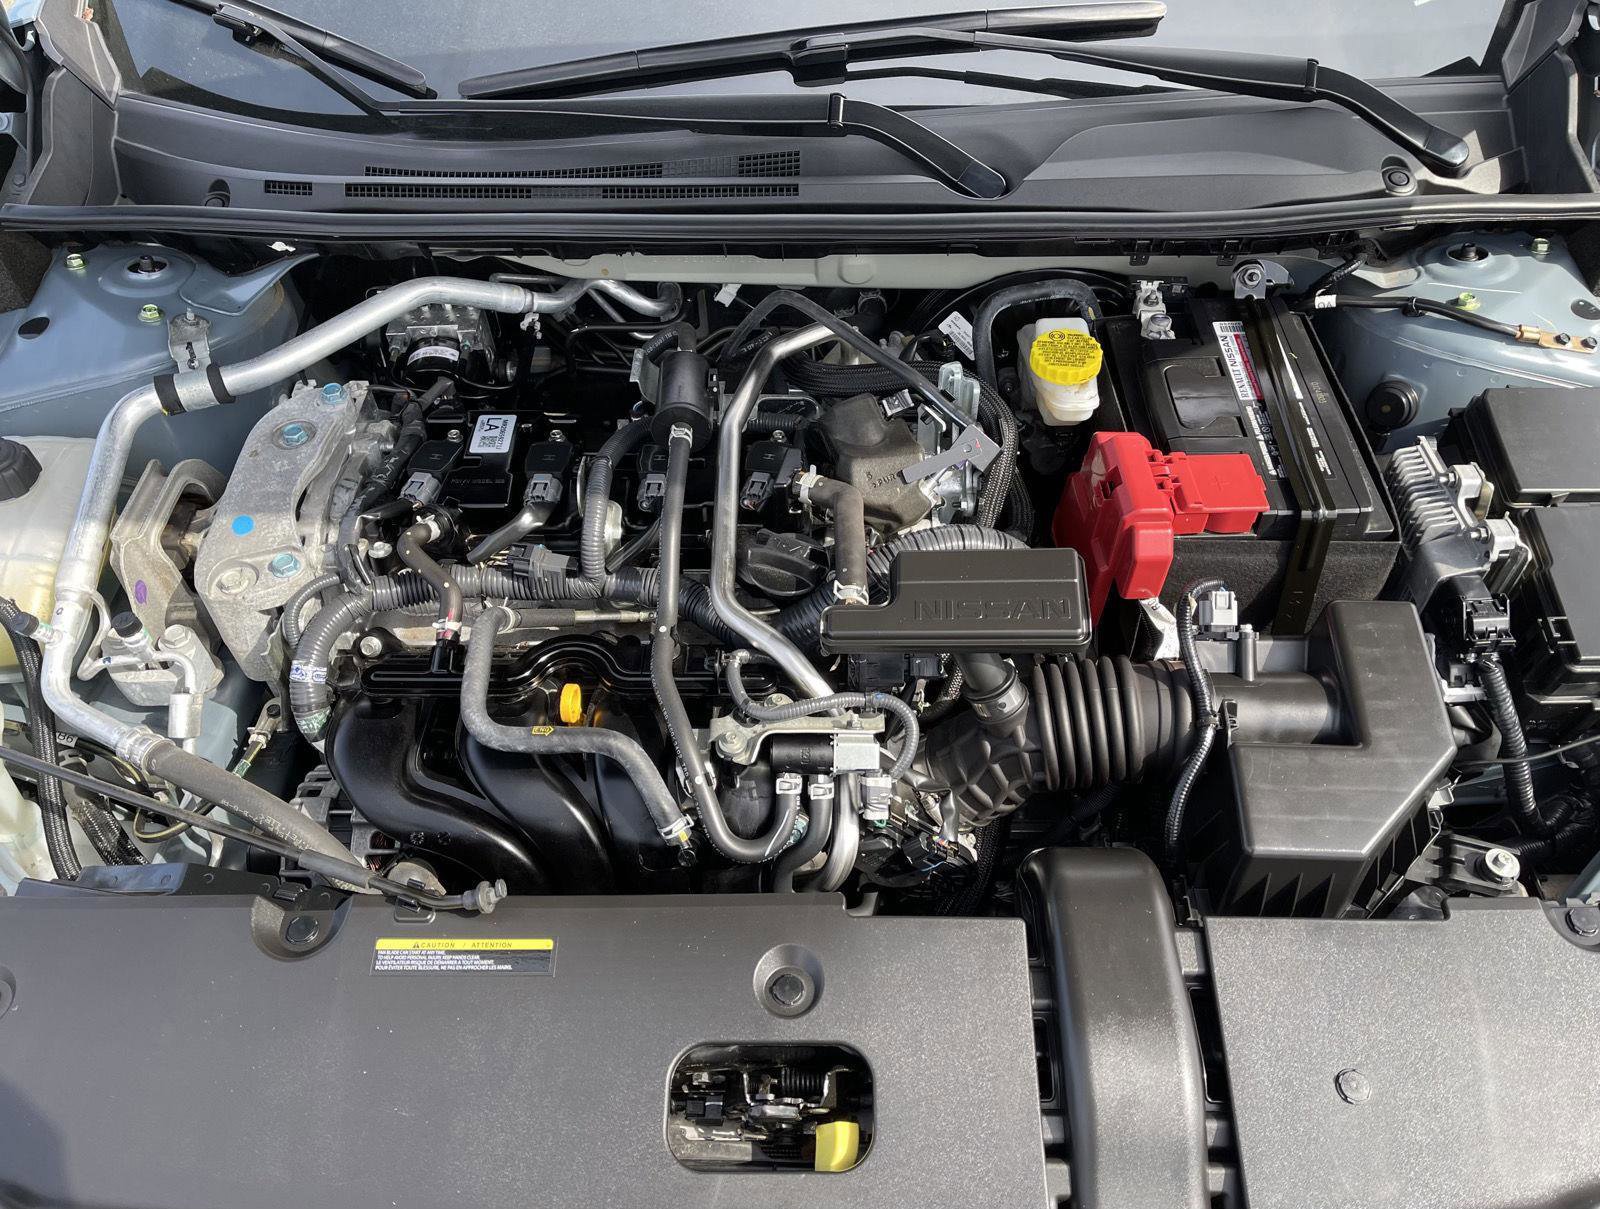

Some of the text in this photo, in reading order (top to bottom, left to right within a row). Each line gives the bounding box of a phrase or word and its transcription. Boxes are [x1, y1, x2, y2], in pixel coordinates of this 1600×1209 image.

[1221, 335, 1239, 367] NISSAN
[484, 417, 502, 431] LA
[914, 599, 1072, 620] NISSAN
